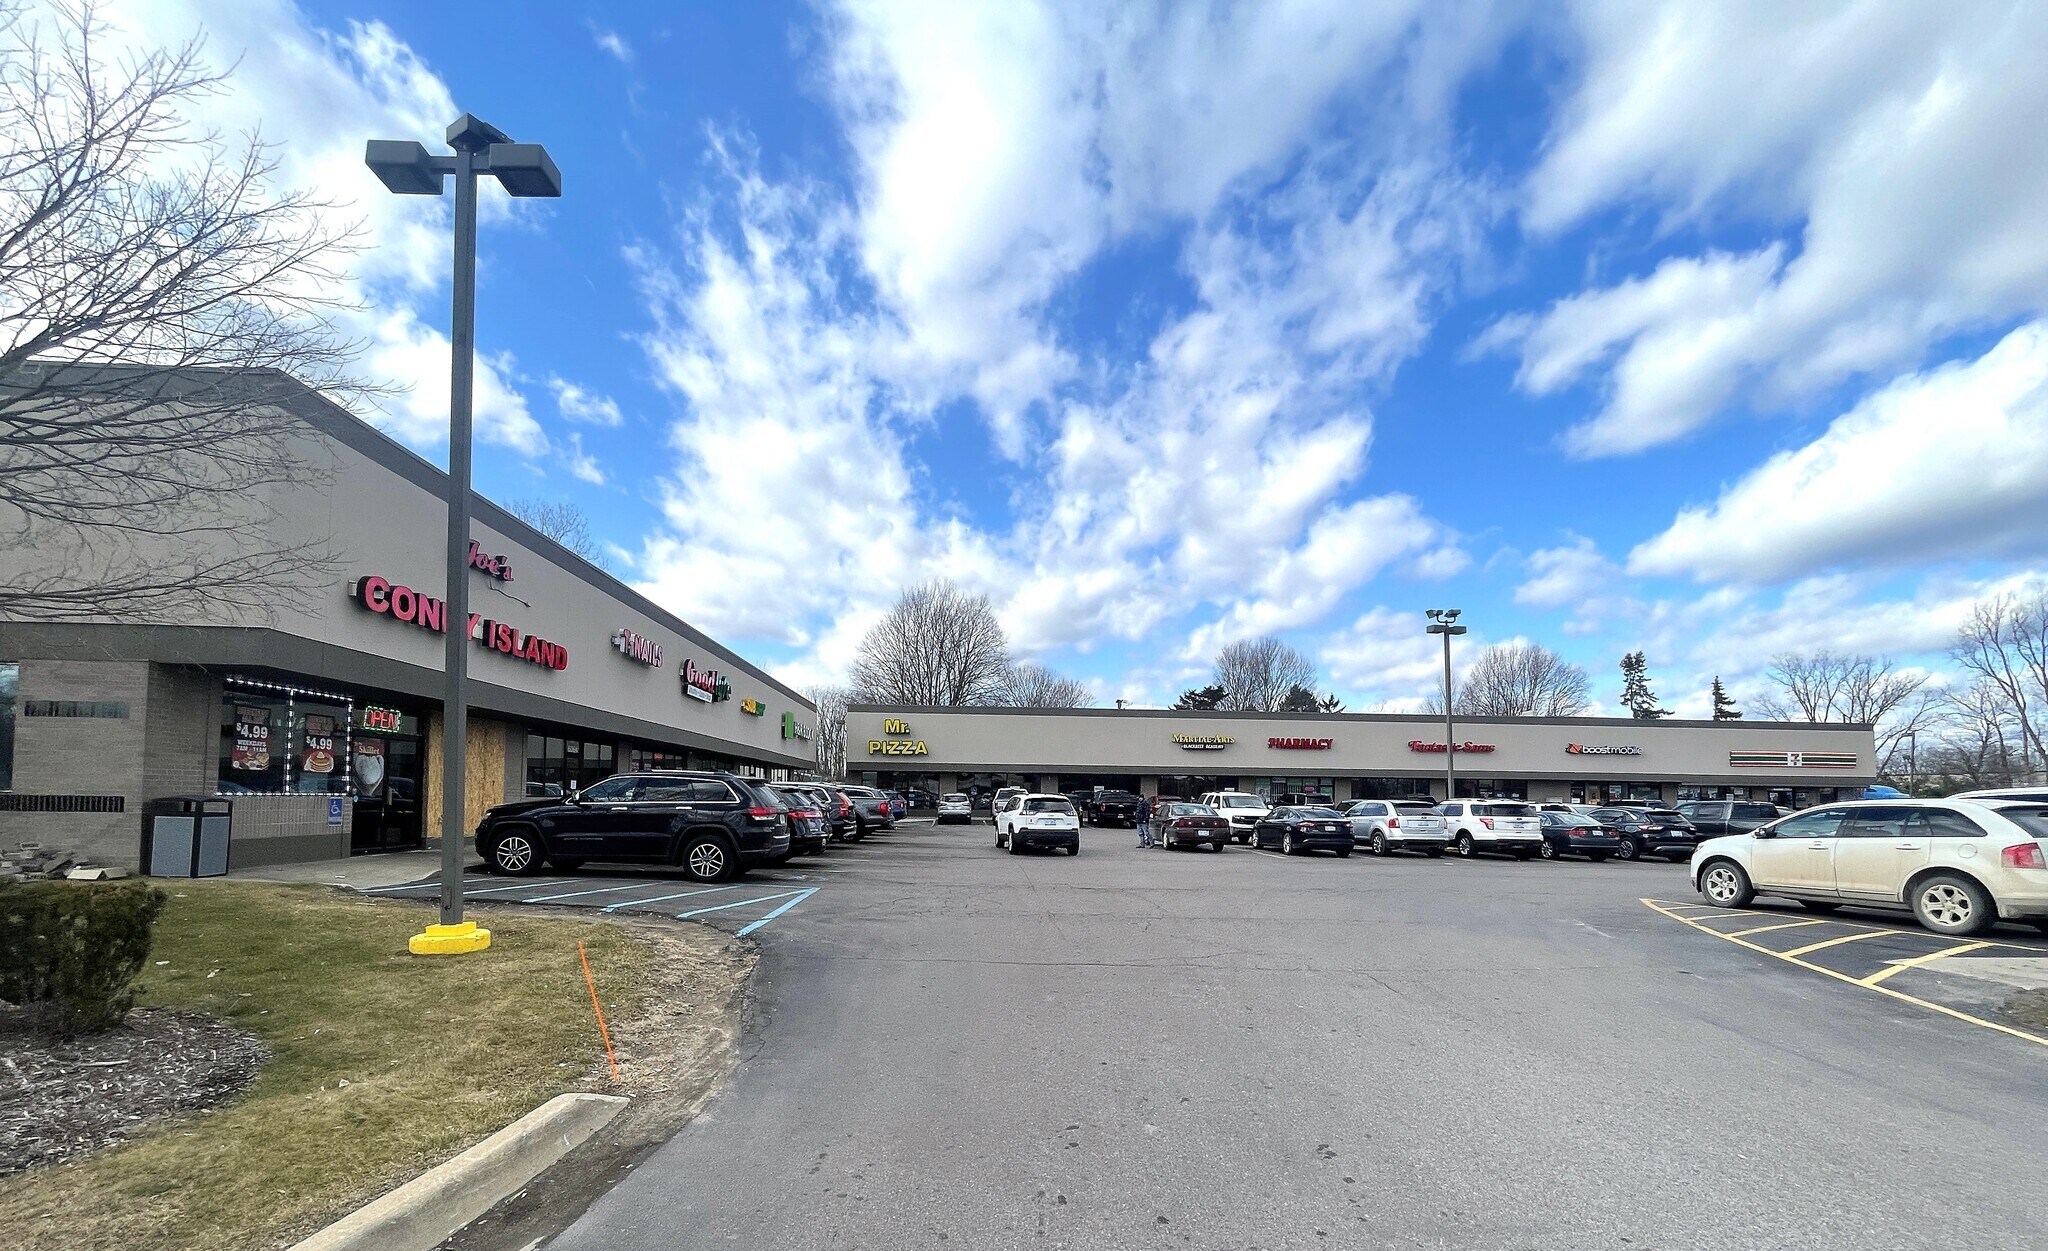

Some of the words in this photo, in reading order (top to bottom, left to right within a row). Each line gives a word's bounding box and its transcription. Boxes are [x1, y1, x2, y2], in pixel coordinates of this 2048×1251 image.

[361, 576, 480, 641] CONY
[484, 619, 568, 671] ISLAND
[366, 709, 398, 729] OPEN
[885, 719, 910, 734] Mr.
[236, 722, 268, 738] $4.99
[306, 735, 332, 750] $4.99
[869, 740, 928, 755] PIZZA
[1268, 737, 1333, 750] PHARMACY
